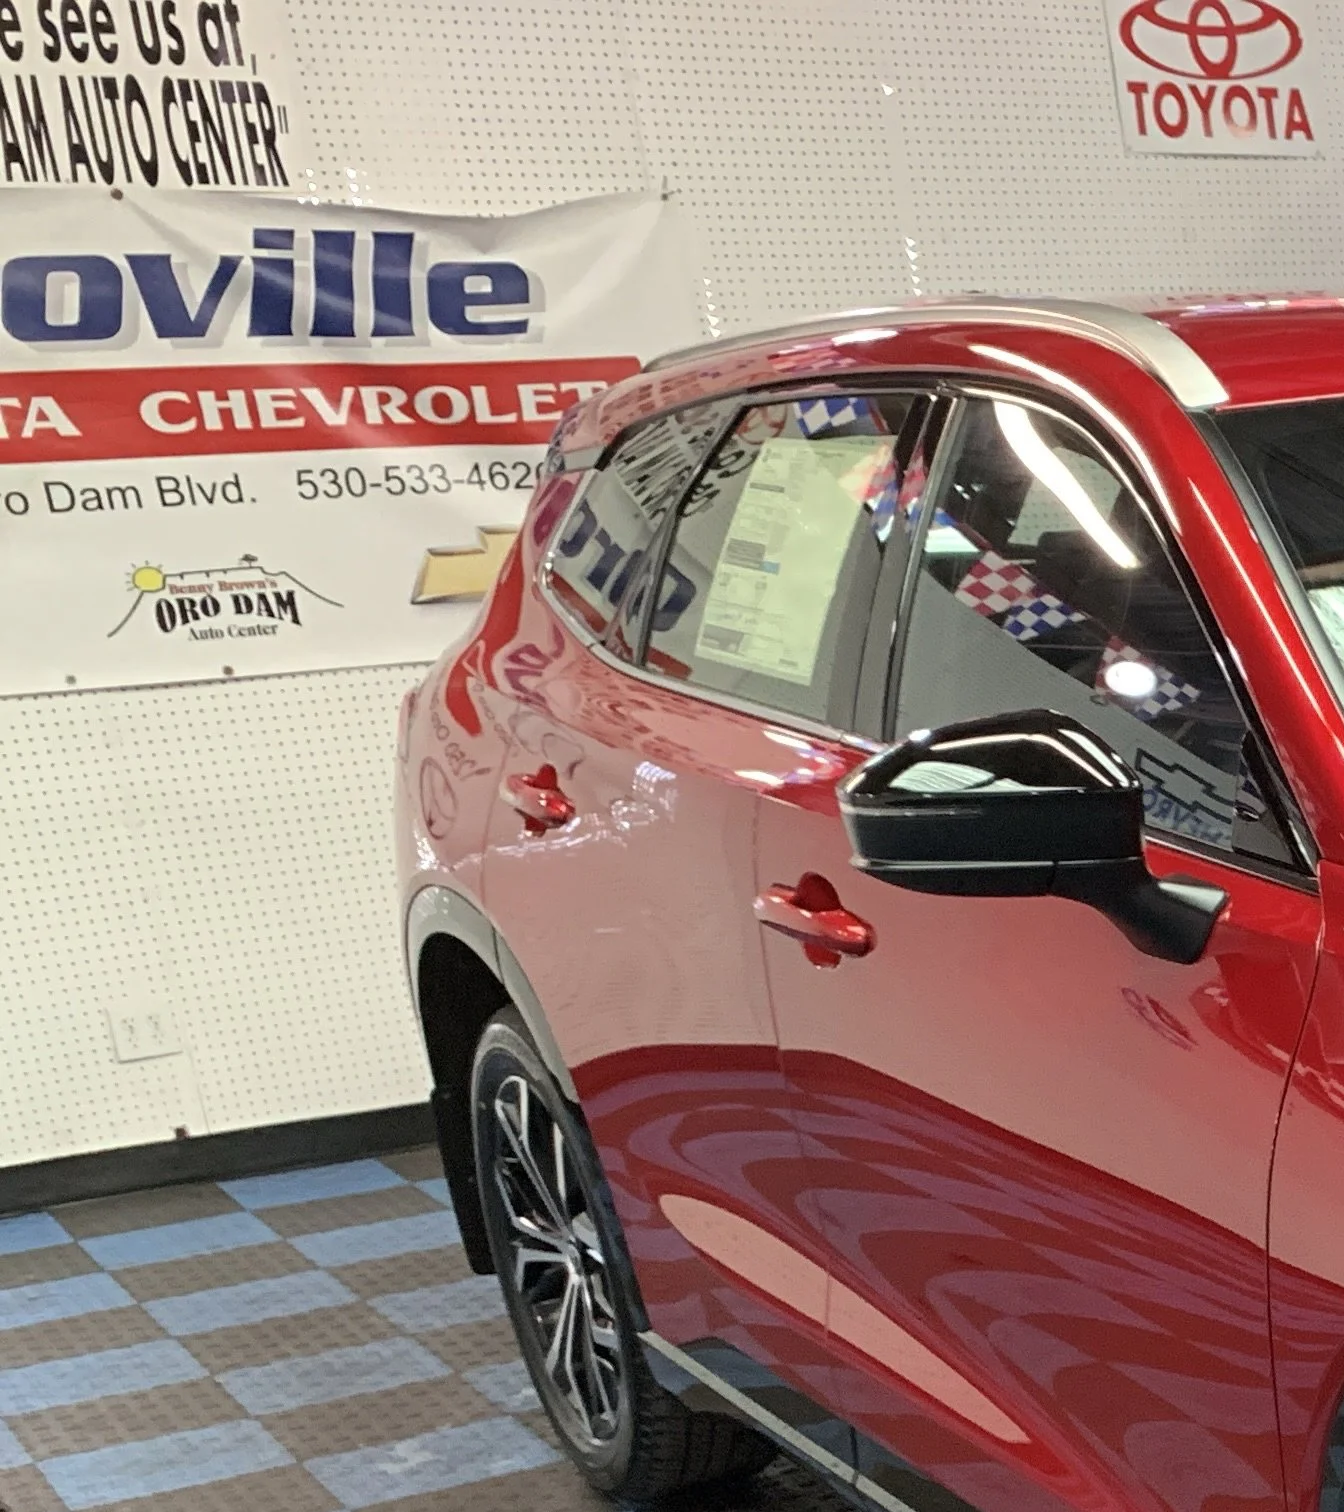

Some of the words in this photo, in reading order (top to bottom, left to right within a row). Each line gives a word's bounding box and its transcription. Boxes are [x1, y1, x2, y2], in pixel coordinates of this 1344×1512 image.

[38, 0, 118, 64] see
[129, 0, 186, 66] us
[59, 74, 159, 187] AUTO
[1126, 80, 1314, 141] TOYOTA
[1, 228, 530, 341] oville
[140, 381, 609, 434] CHEVROLET
[43, 481, 143, 514] Dam
[156, 474, 258, 508] Blvd.
[155, 595, 221, 633] ORO
[230, 589, 302, 627] DAM
[168, 582, 214, 595] Benny
[217, 579, 278, 592] Brown's
[188, 625, 225, 641] Auto
[227, 624, 279, 639] Center
